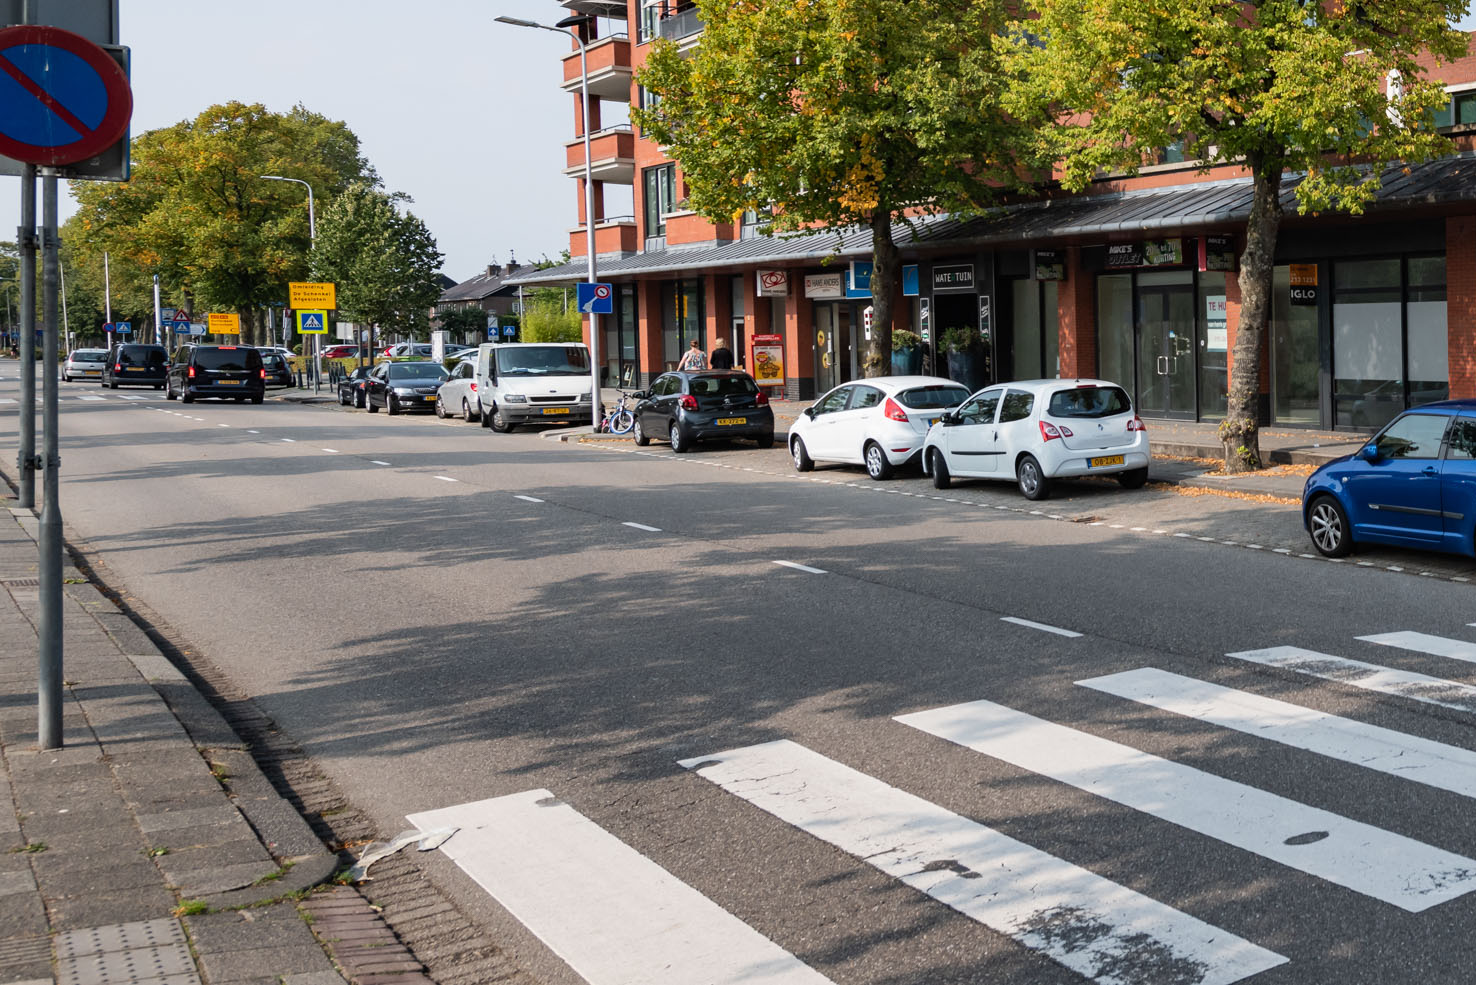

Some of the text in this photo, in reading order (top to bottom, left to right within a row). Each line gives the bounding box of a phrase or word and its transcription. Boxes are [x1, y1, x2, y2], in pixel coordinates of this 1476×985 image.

[1109, 245, 1133, 254] MIKE'S
[1109, 254, 1142, 265] OUTLET
[1154, 252, 1176, 264] KORTING
[824, 278, 839, 286] ANDERS
[1291, 289, 1316, 299] IGLO
[1208, 301, 1216, 311] TE
